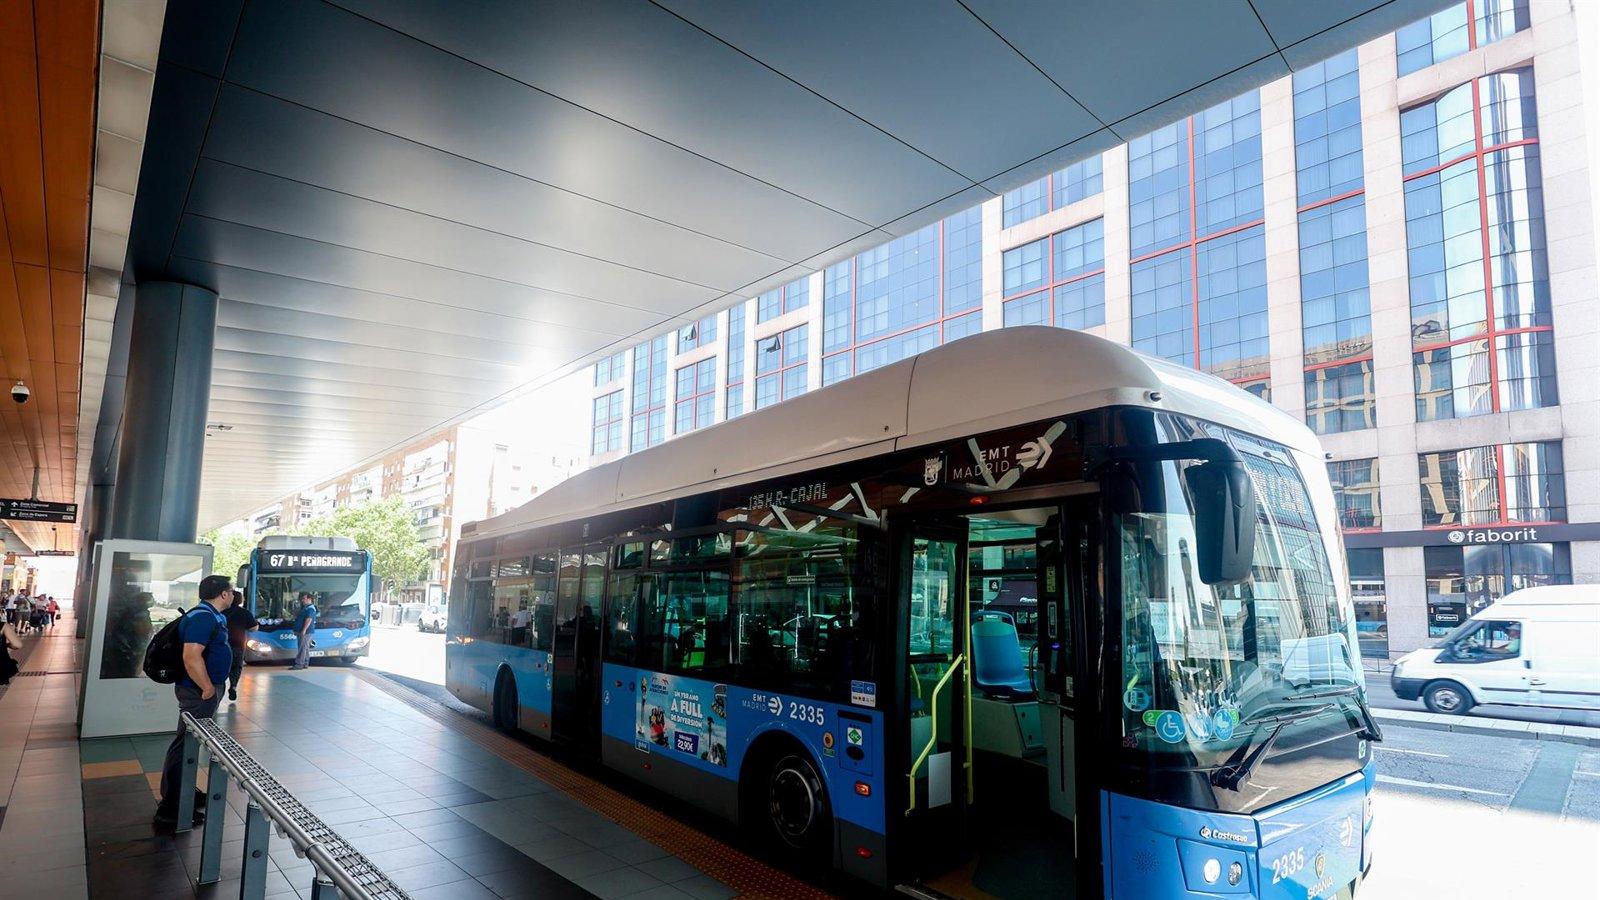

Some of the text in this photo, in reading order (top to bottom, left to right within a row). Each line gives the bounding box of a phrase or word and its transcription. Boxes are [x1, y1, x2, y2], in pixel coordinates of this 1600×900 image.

[980, 446, 1010, 461] EMT
[952, 460, 1010, 480] MADRID
[1466, 527, 1537, 543] faborit
[270, 554, 285, 567] 67
[742, 700, 767, 712] MADRID
[752, 693, 766, 703] EMT
[670, 698, 703, 718] A FULL
[789, 701, 825, 726] 2335
[1271, 847, 1304, 885] 2335
[1307, 877, 1334, 900] SCANIA
